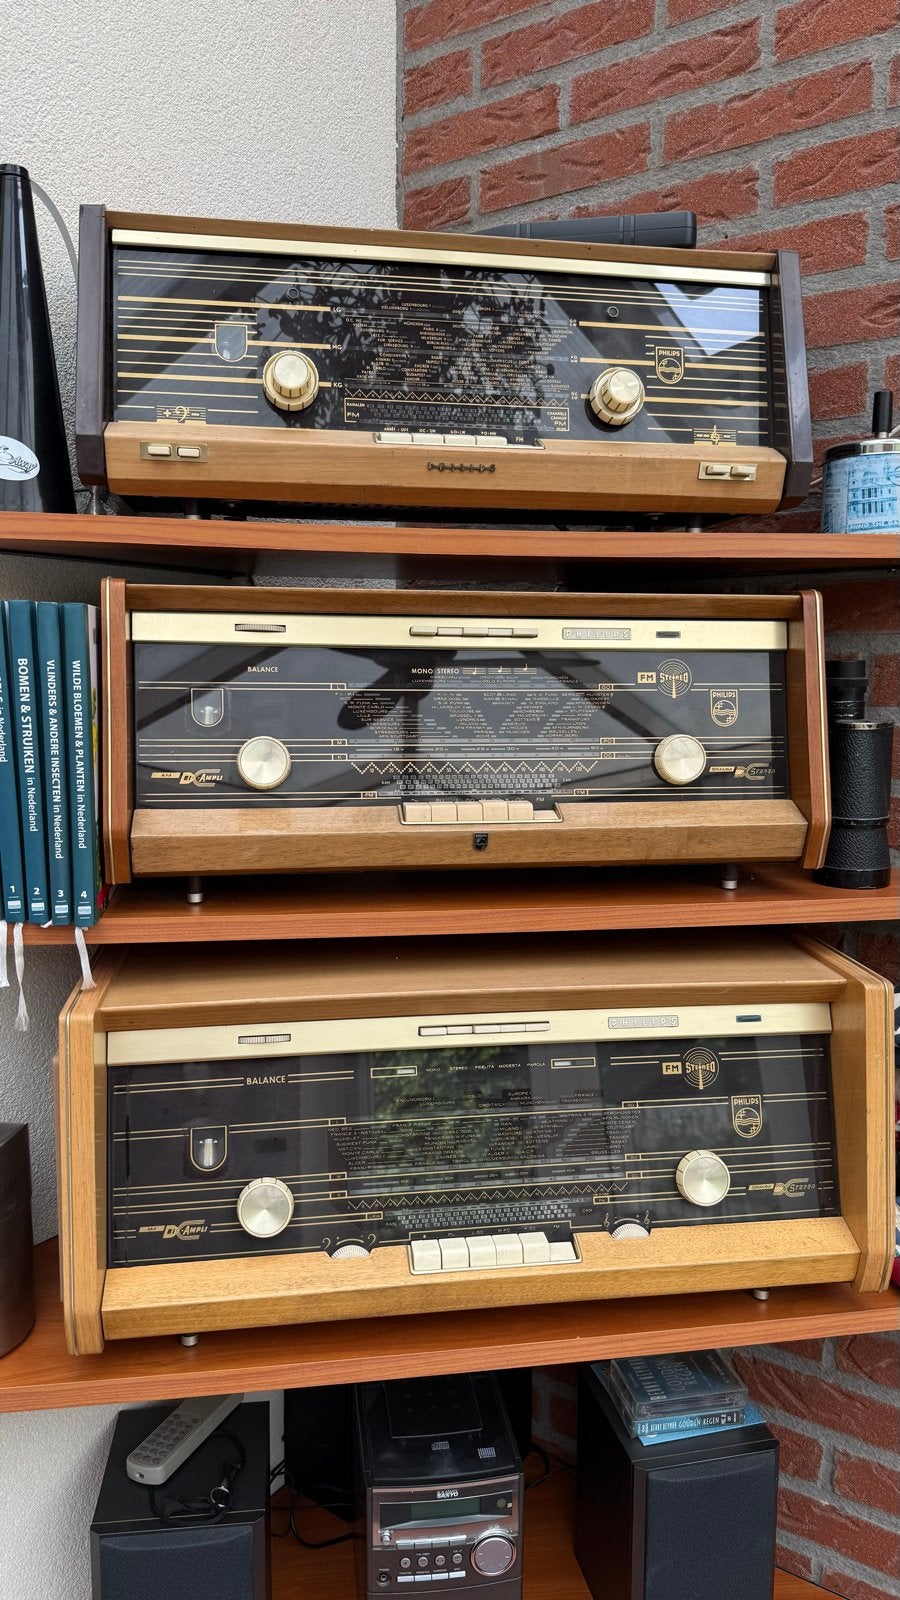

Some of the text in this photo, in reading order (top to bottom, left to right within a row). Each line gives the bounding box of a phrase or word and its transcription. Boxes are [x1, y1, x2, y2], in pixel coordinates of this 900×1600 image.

[566, 630, 629, 638] PHILIPS
[72, 660, 82, 690] WILDE
[660, 672, 689, 682] STEREO
[46, 660, 56, 706] VLINDERS
[74, 692, 84, 738] BLOEMEN
[49, 718, 60, 755] ANDERE
[18, 658, 38, 832] BOMEN & STRUIKEN in Nederland
[76, 749, 85, 791] PLANTEN
[50, 758, 62, 802] INSECTEN
[76, 794, 85, 802] in
[53, 804, 62, 813] in
[77, 804, 87, 848] Nederland
[54, 814, 64, 858] Nederland
[34, 887, 40, 895] 2
[58, 890, 64, 898] 3
[612, 1018, 676, 1027] PHILIPS
[665, 1064, 680, 1072] FM
[686, 1062, 716, 1074] STEREO
[246, 1076, 286, 1086] BALANCE
[733, 1098, 759, 1106] PHILIPS
[703, 1416, 720, 1425] REGEN
[436, 1489, 459, 1499] SANYO
